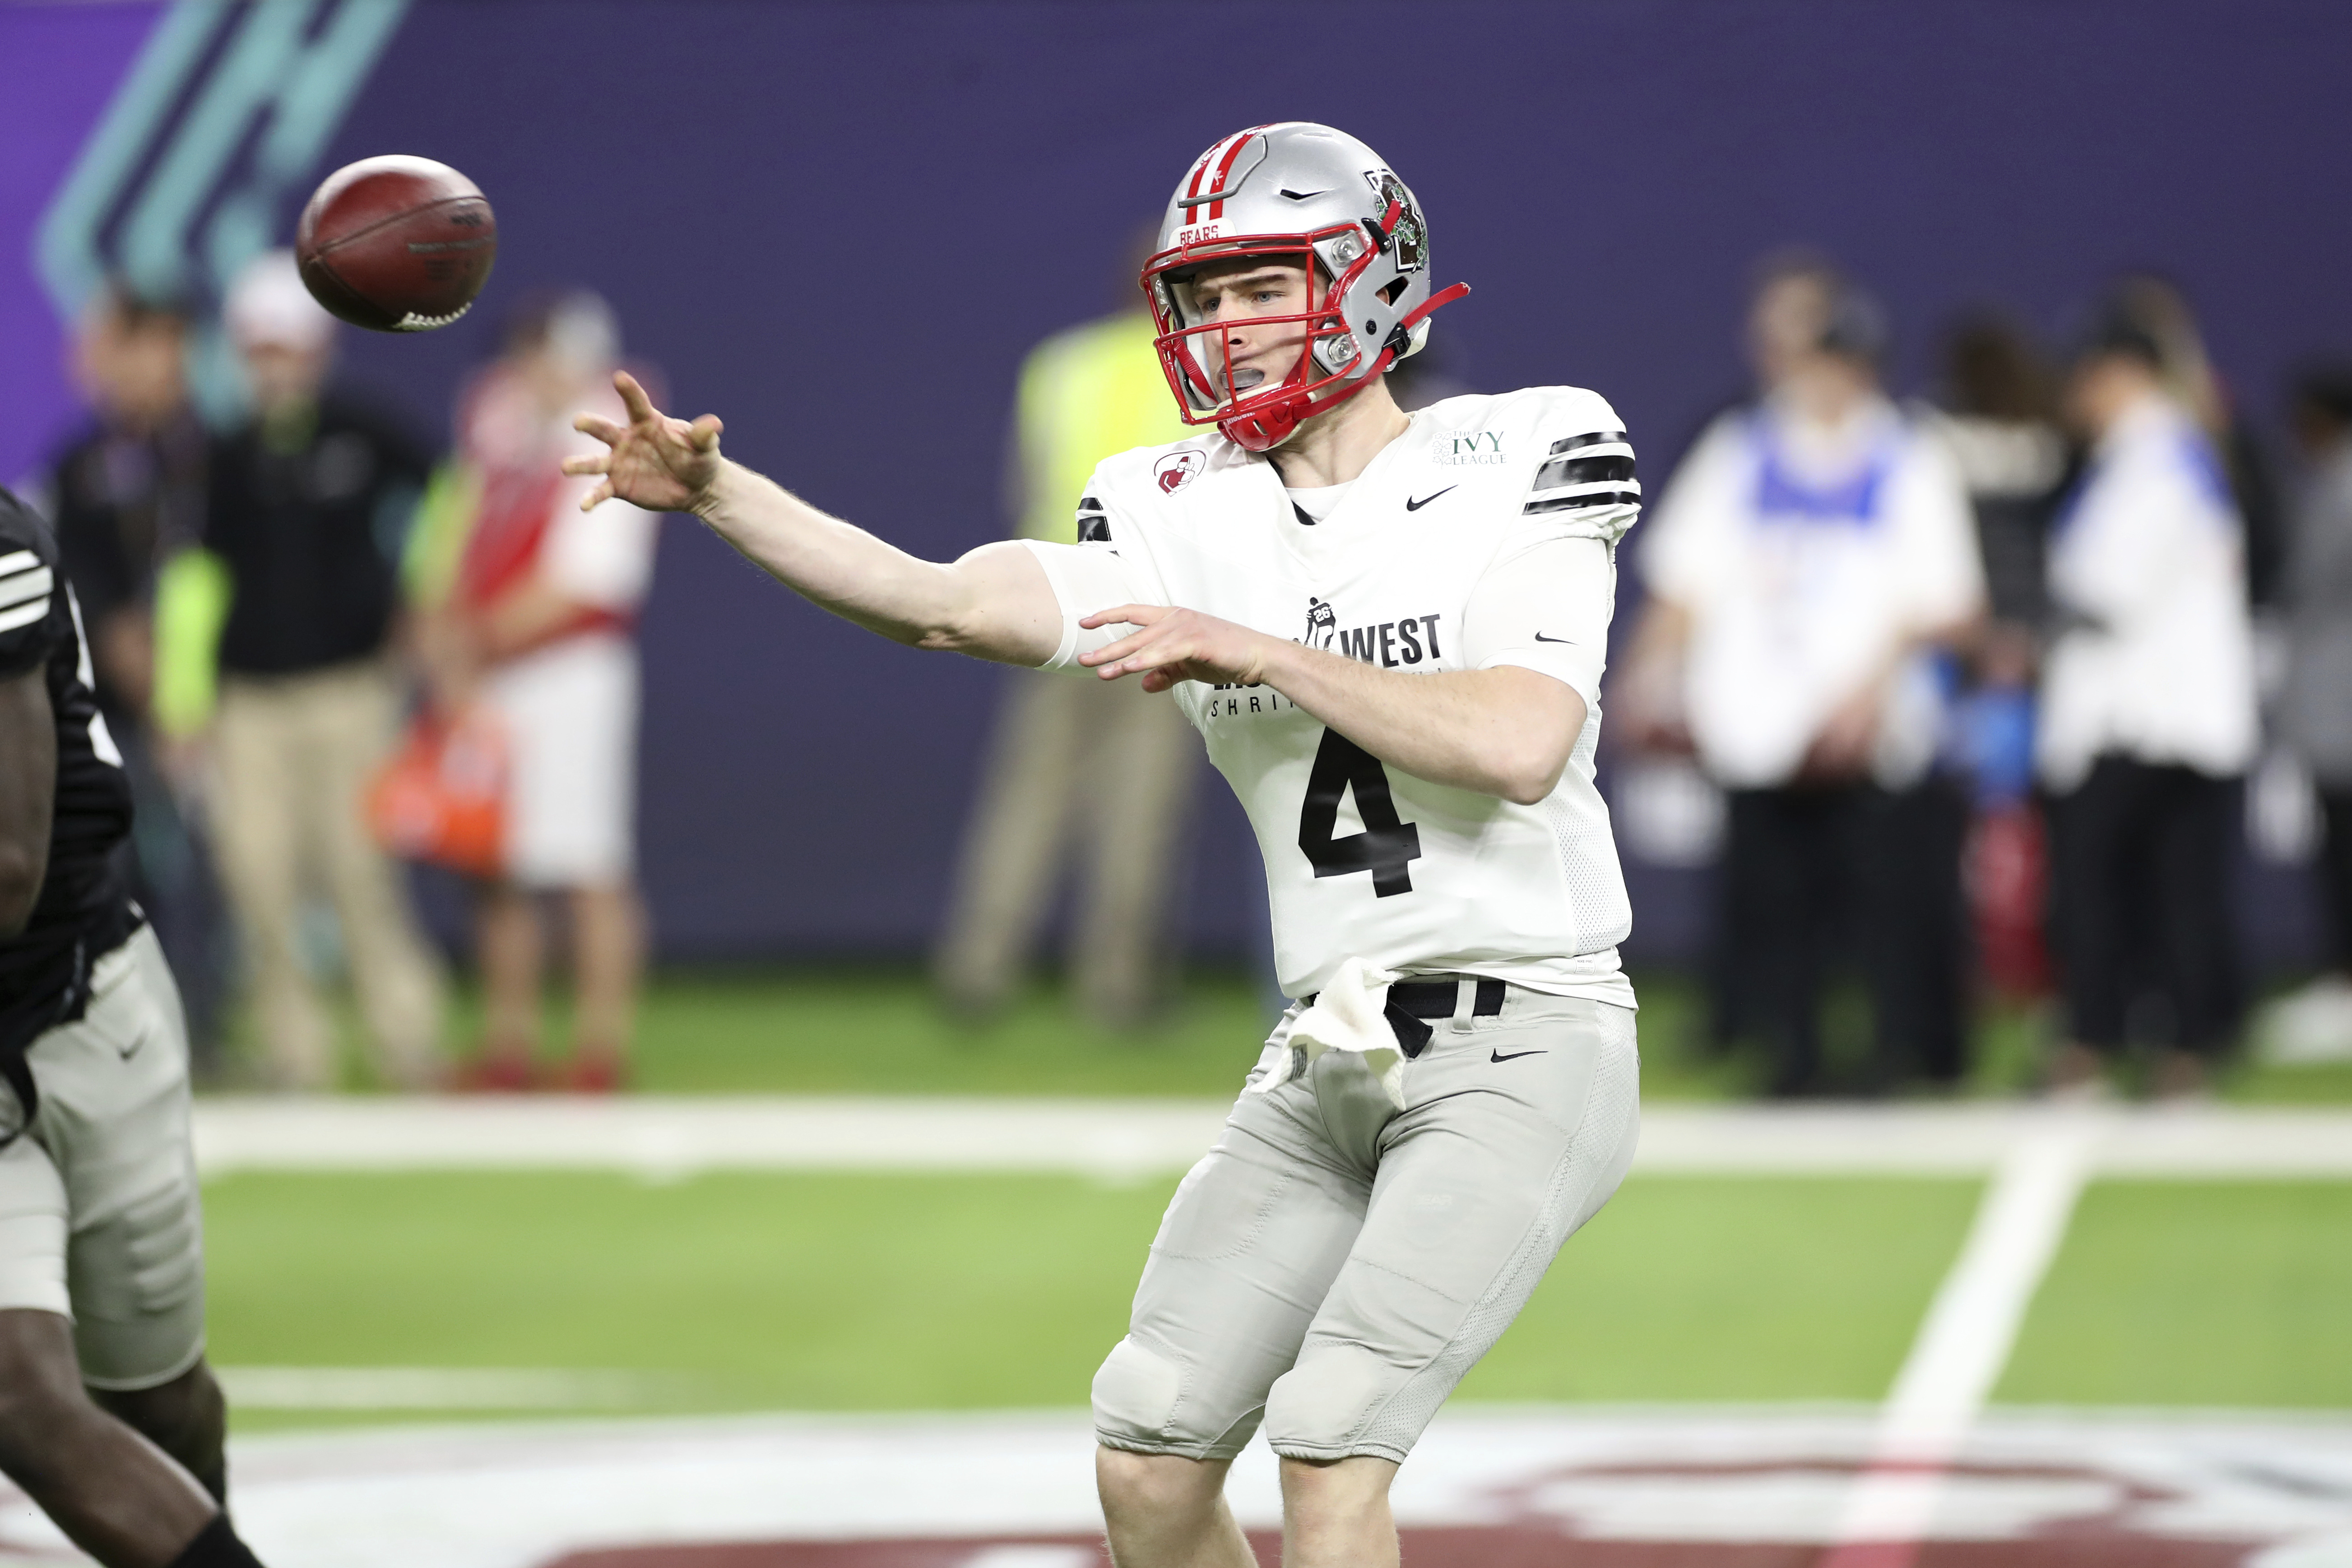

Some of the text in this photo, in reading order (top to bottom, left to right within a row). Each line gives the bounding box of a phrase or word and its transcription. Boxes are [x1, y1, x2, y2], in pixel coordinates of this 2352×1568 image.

[1180, 225, 1219, 245] BEARS
[1452, 431, 1504, 455] IVY
[1453, 454, 1507, 465] LEAGUE
[1313, 606, 1331, 623] 26
[1340, 613, 1441, 668] WEST
[1211, 694, 1294, 717] SHRI
[1298, 726, 1421, 899] 4
